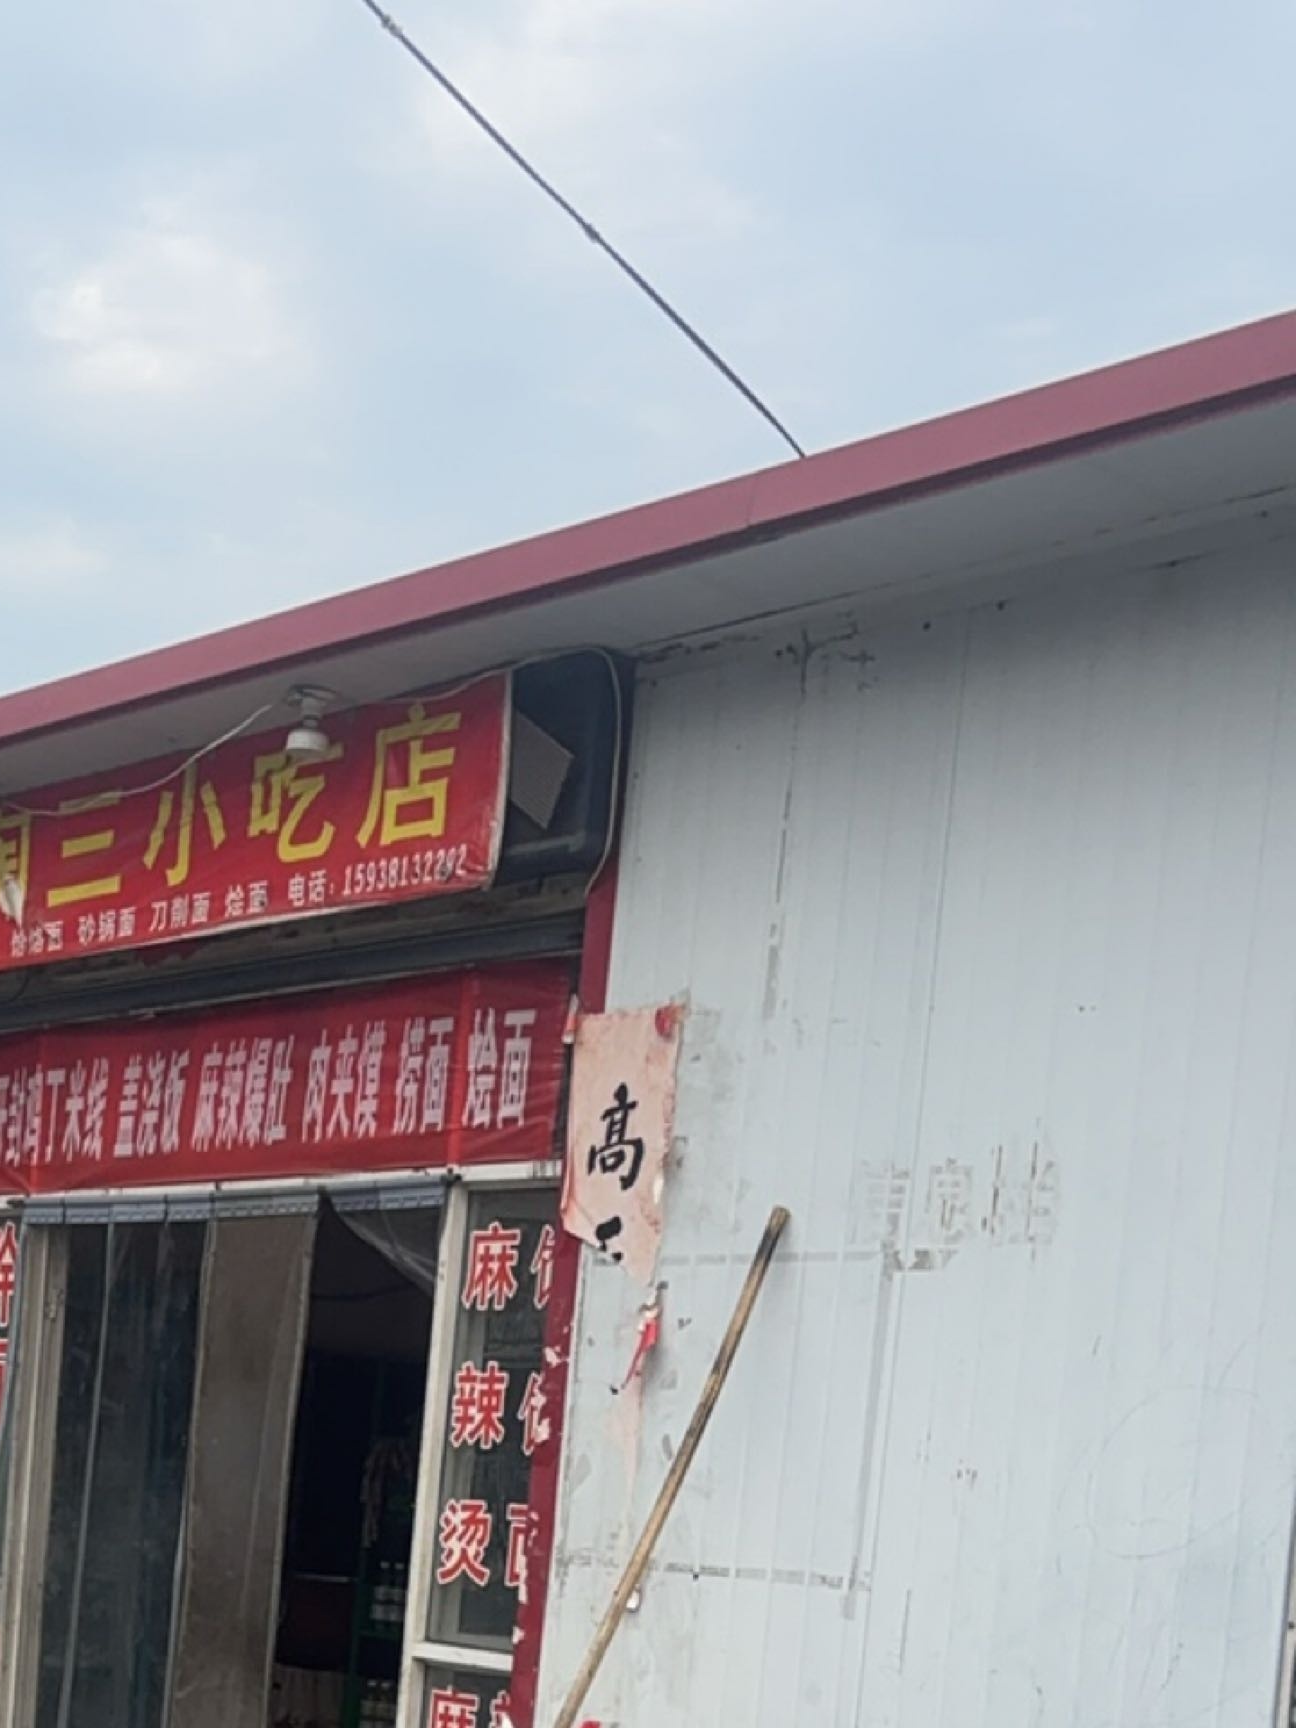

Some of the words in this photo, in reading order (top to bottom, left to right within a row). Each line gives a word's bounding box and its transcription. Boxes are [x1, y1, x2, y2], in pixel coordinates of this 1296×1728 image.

[148, 891, 211, 933] 刀削面
[113, 1049, 190, 1159] 盖浇饭
[391, 1015, 454, 1136] 捞面
[461, 1007, 537, 1130] 烩面
[438, 1221, 521, 1587] 麻辣烫
